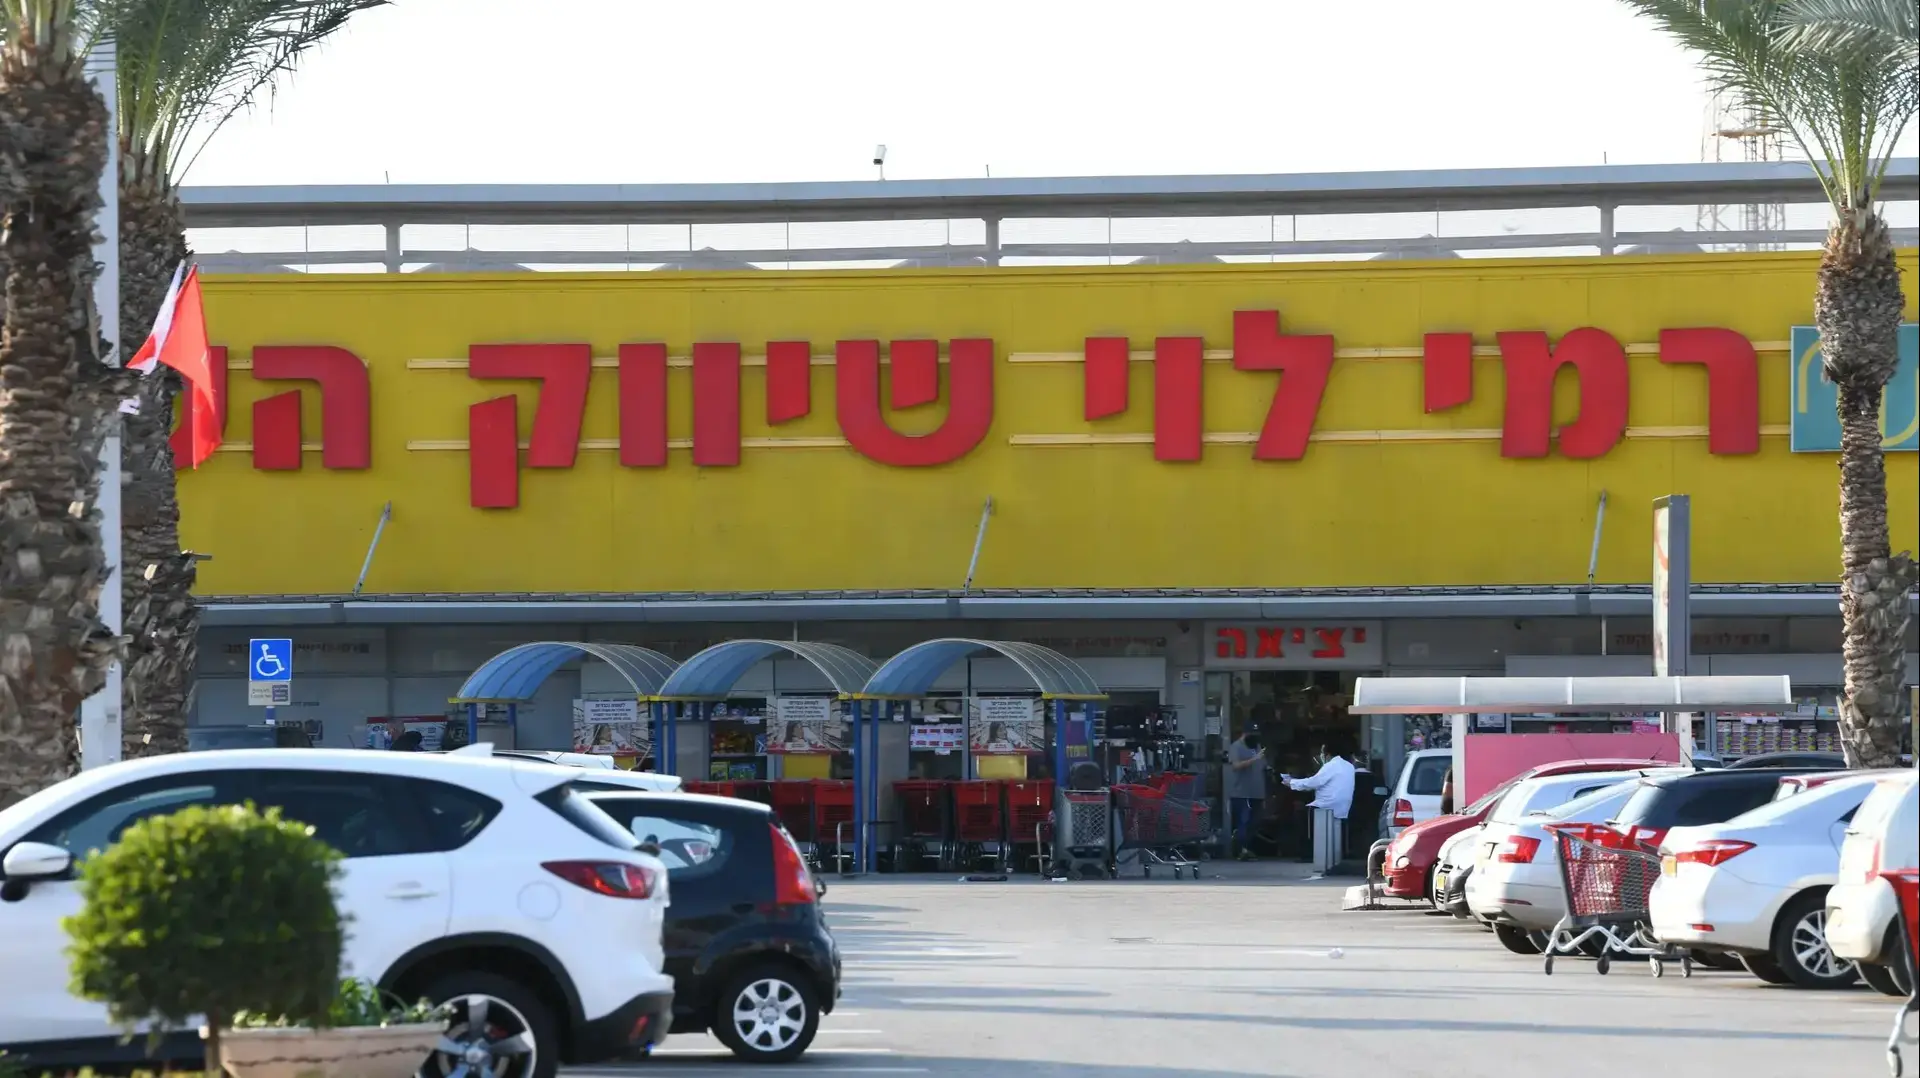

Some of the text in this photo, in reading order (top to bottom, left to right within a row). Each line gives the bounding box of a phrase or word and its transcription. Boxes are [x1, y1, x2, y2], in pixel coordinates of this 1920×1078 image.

[469, 339, 993, 508] שיווק
[1085, 310, 1334, 461] לוי
[1424, 327, 1759, 459] רמי
[1216, 627, 1366, 659] יציאה
